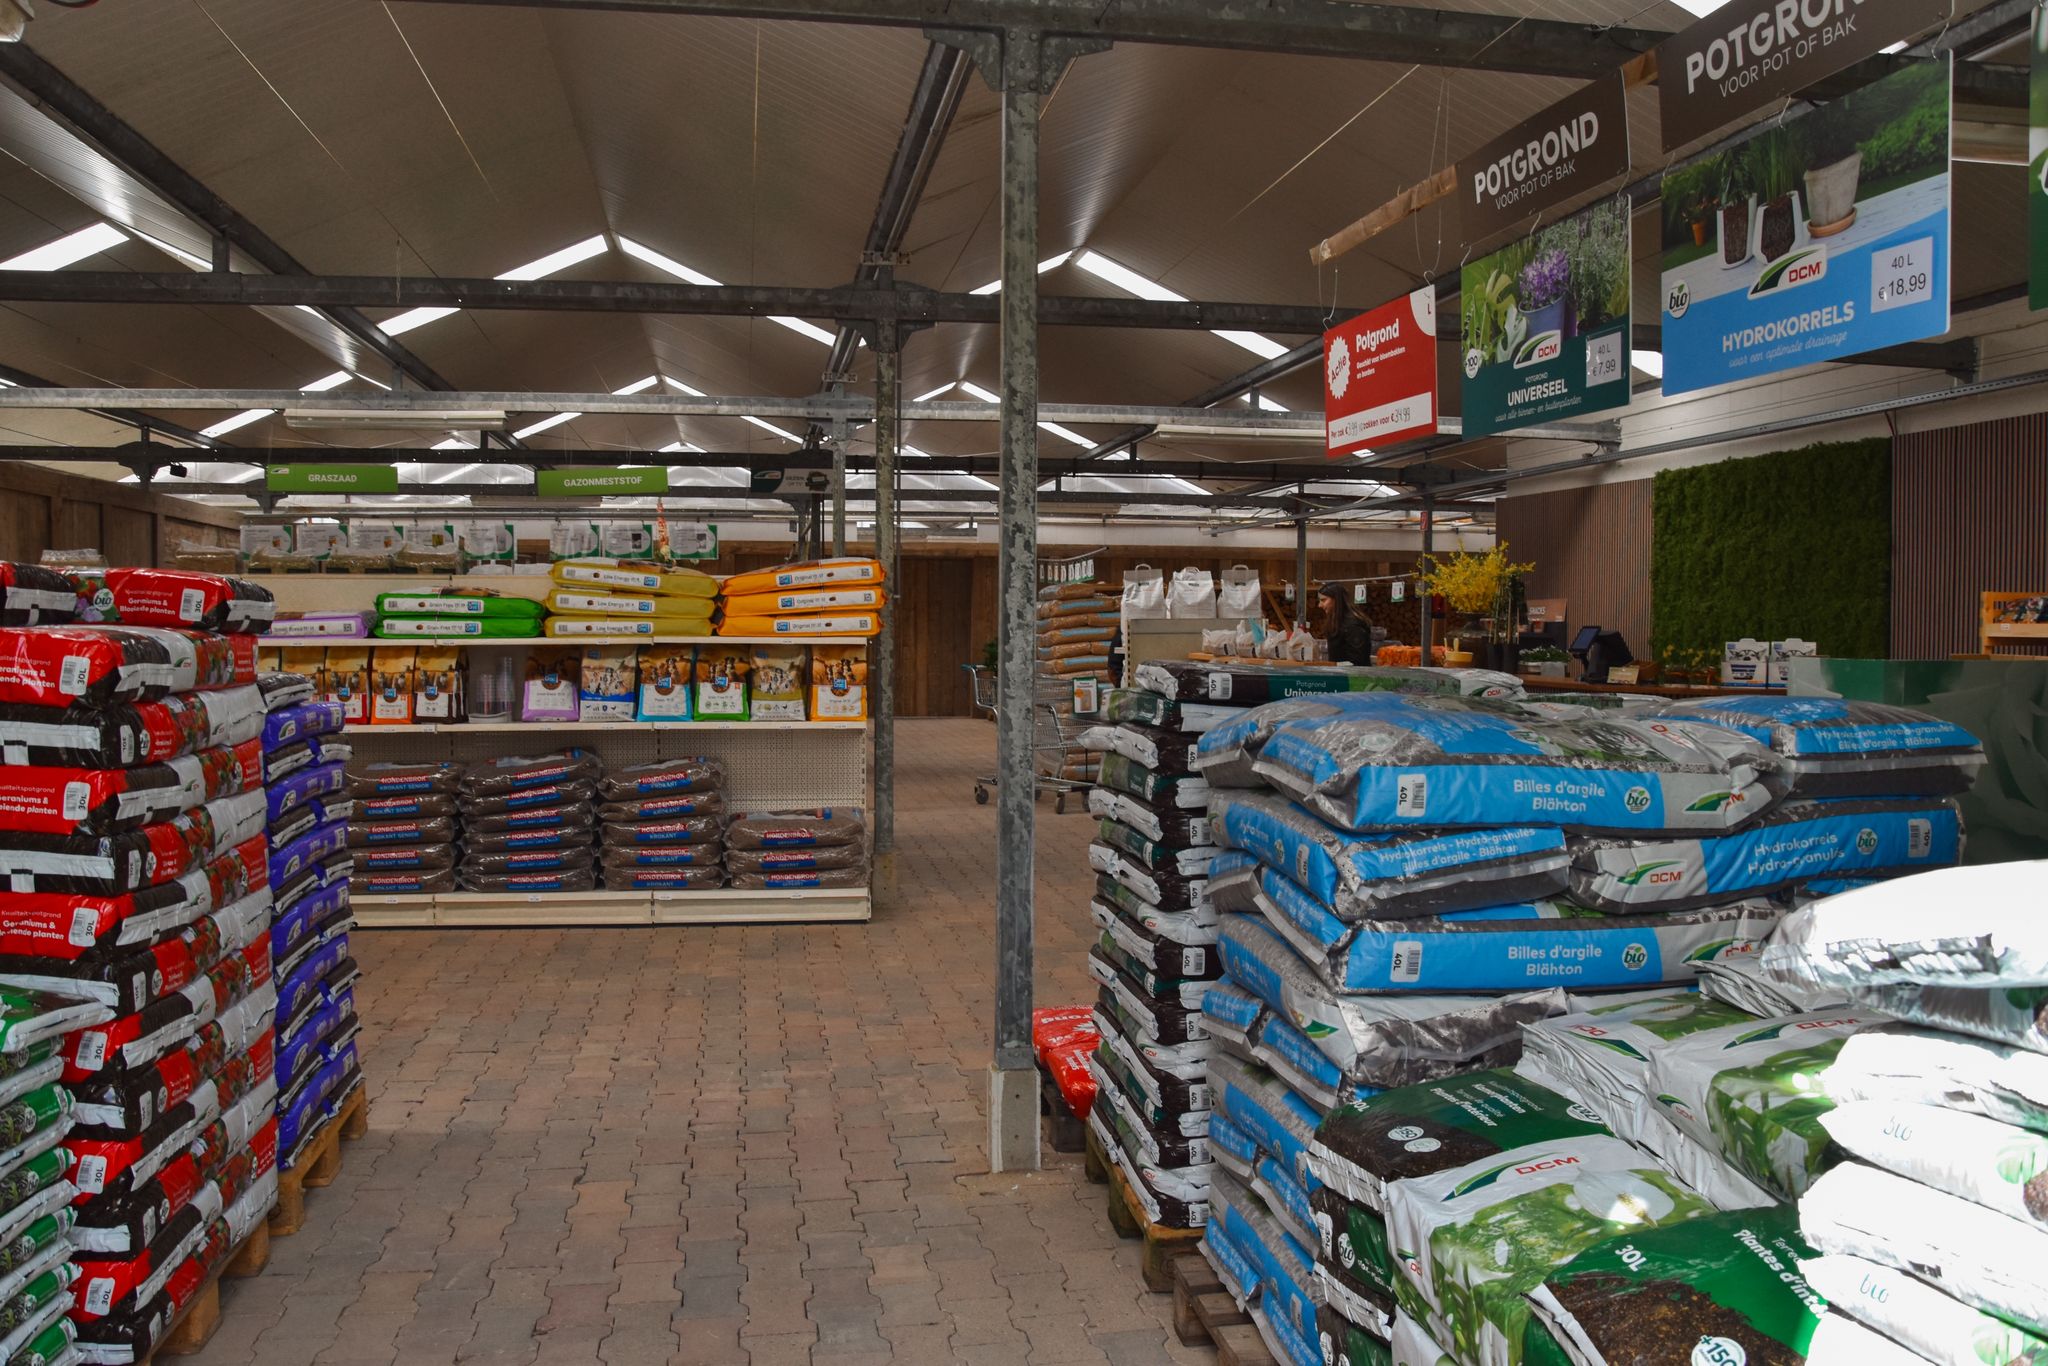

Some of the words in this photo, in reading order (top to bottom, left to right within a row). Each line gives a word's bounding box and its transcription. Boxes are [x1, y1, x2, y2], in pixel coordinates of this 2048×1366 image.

[1719, 67, 1758, 98] VOOR
[1762, 50, 1792, 77] POT
[1796, 34, 1817, 59] OF
[1822, 15, 1857, 47] BAK
[1474, 111, 1599, 204] POTGROND
[1495, 187, 1519, 210] VOOR
[1521, 177, 1538, 198] POT
[1539, 170, 1554, 187] OF
[1555, 160, 1576, 181] BAK
[1891, 255, 1905, 269] 40
[1907, 253, 1914, 266] L
[1788, 261, 1821, 284] DCM
[1668, 289, 1688, 311] bio
[1356, 317, 1399, 352] Potgrond
[1722, 300, 1856, 353] HYDROKORRELS
[1804, 329, 1848, 353] drainage
[1538, 343, 1558, 358] DCM
[1331, 355, 1346, 384] Actie
[1507, 378, 1568, 407] UNIVERSEEL
[308, 473, 357, 483] GRASZAAD
[563, 475, 643, 488] GAZONMESTSTOF
[150, 606, 176, 616] planten
[39, 668, 46, 677] &
[77, 668, 86, 685] 30L
[22, 677, 56, 689] planten
[1296, 680, 1327, 690] Potgrond
[1863, 738, 1897, 750] d'argile
[1399, 786, 1407, 806] 40L
[1513, 779, 1551, 793] Billes
[1555, 780, 1606, 797] d'argile
[43, 796, 49, 804] &
[78, 792, 87, 811] 30L
[1532, 797, 1587, 812] Blähton
[1626, 794, 1649, 807] bio
[26, 805, 57, 815] planten
[1754, 833, 1838, 857] Hydrokorrels
[1856, 834, 1877, 849] bio
[1380, 841, 1447, 864] Hydrokorrels
[1402, 858, 1429, 873] Billes
[1431, 851, 1470, 869] d'argile
[1478, 844, 1518, 858] Blähton
[1650, 872, 1682, 884] DCM
[48, 921, 56, 930] &
[86, 919, 94, 936] 30L
[33, 930, 64, 940] planten
[1393, 953, 1401, 971] 40L
[1508, 946, 1546, 960] Billes
[1550, 946, 1603, 961] d'argile
[1622, 949, 1646, 964] bio
[1526, 963, 1583, 976] Blähton
[1796, 1018, 1861, 1030] DCM
[95, 1043, 104, 1060] 30L
[1515, 1156, 1580, 1175] DCM
[94, 1166, 104, 1185] 30L
[1614, 1243, 1648, 1272] 30L
[1733, 1229, 1785, 1272] Plantes
[102, 1288, 112, 1305] 30L
[1859, 1273, 1889, 1304] bio
